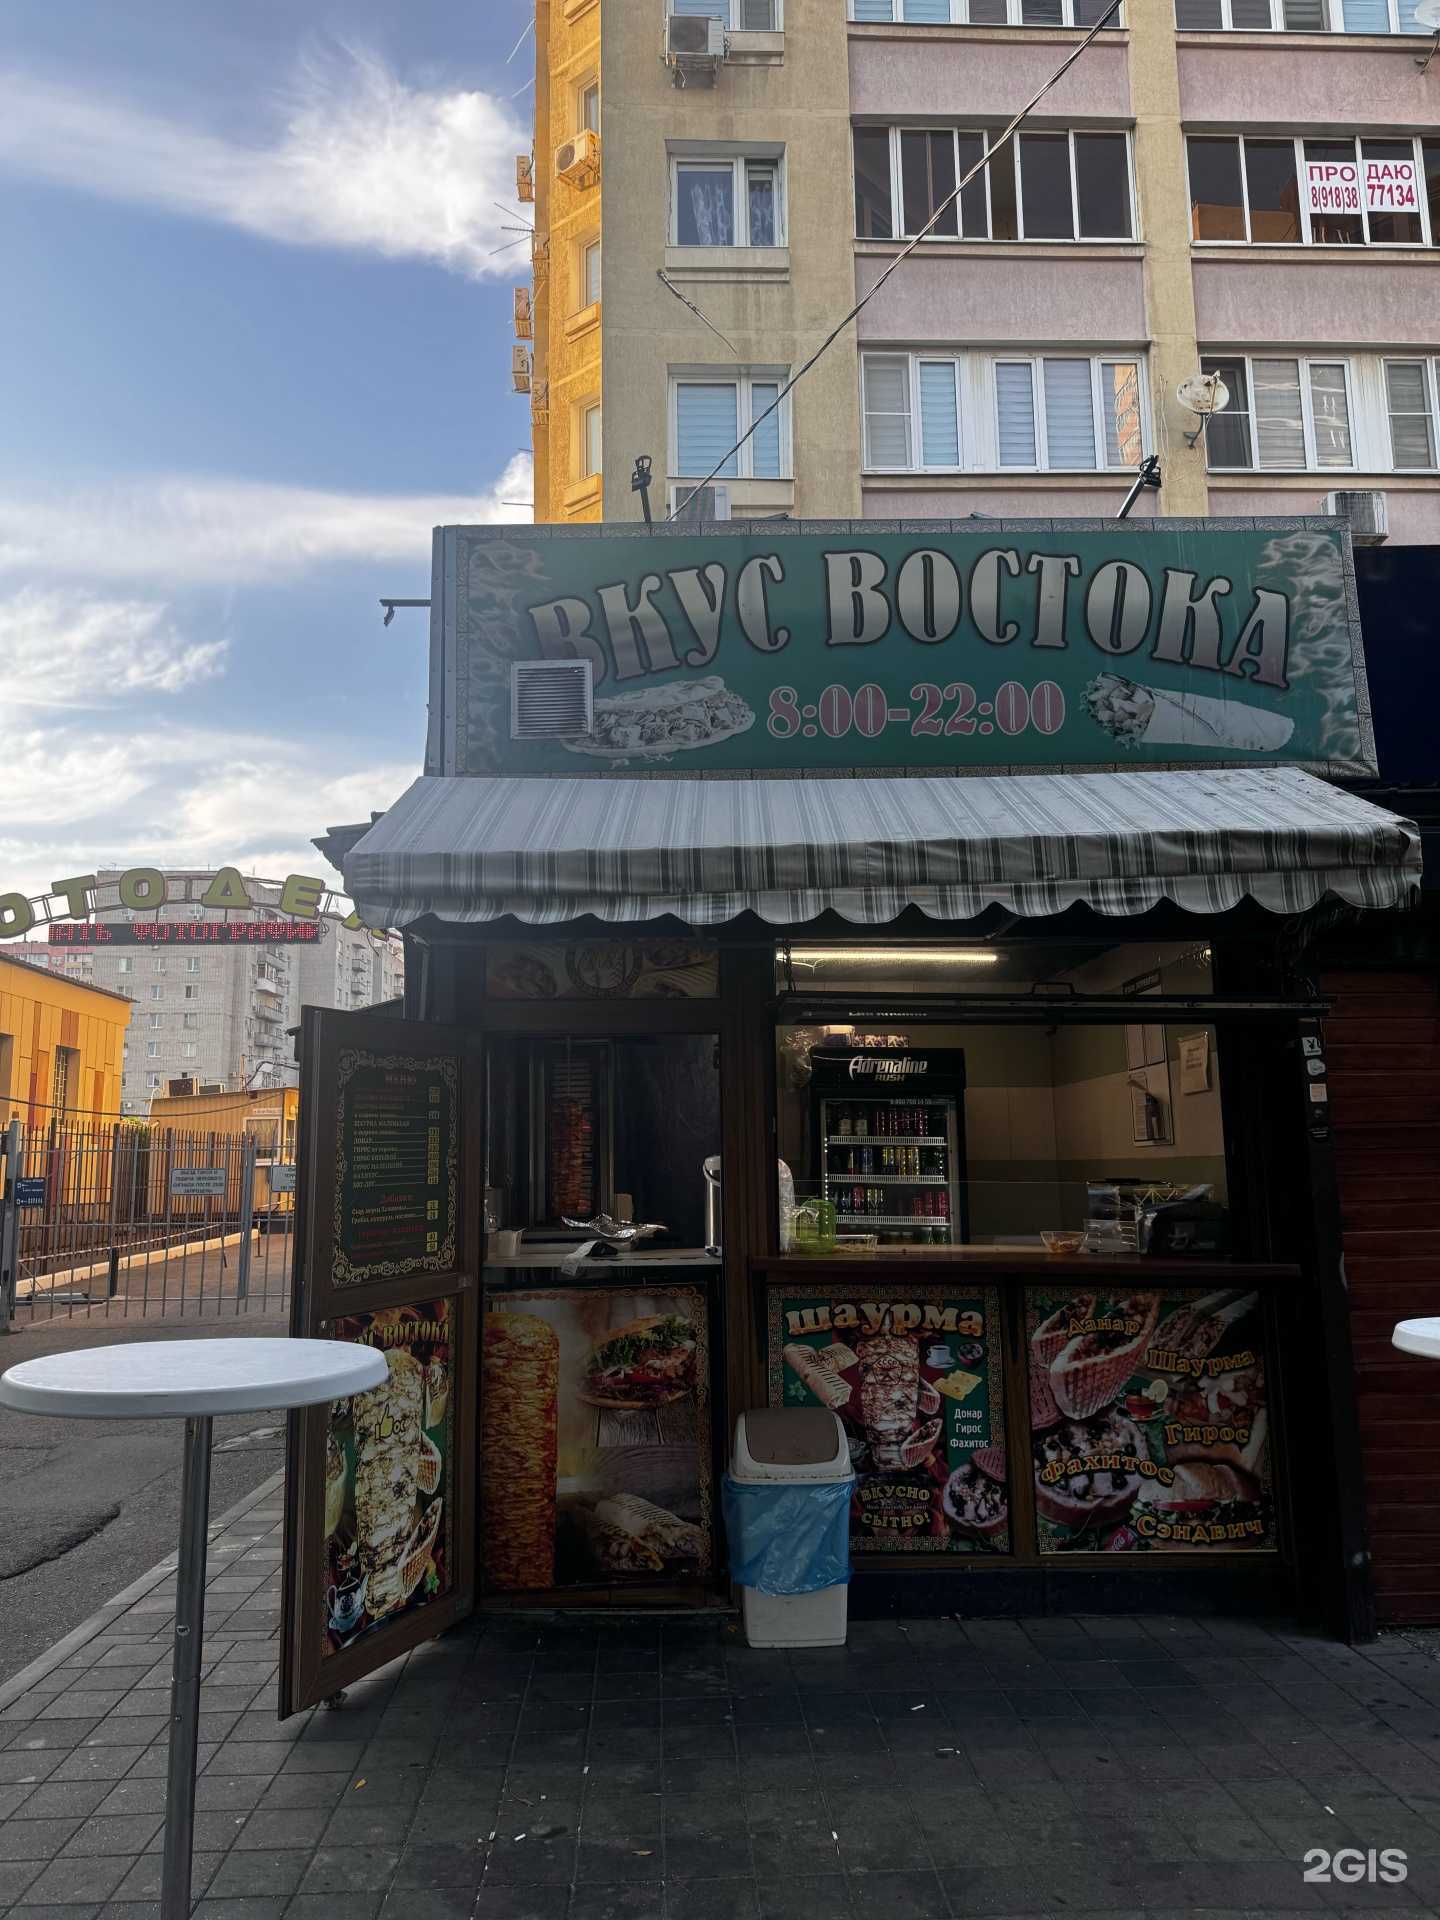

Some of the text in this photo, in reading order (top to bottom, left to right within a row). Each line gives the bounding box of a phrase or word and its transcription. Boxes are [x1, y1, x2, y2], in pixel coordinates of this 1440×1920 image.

[1309, 164, 1413, 182] ПРО ДАЮ
[1311, 183, 1415, 214] 8(918)38 77134
[823, 548, 1294, 690] ВОСТОКА
[766, 678, 1068, 741] 8:00-22:00
[848, 1055, 929, 1080] Adrenaline
[874, 1073, 906, 1082] RUSH
[383, 1318, 450, 1347] ВОСТОКА
[1146, 1349, 1257, 1378] Шаурма
[953, 1408, 983, 1421] Донар
[955, 1423, 983, 1435] Гирос
[1164, 1423, 1250, 1446] Гирос
[949, 1437, 990, 1449] Фахитос
[1136, 1513, 1266, 1543] Сэндвич
